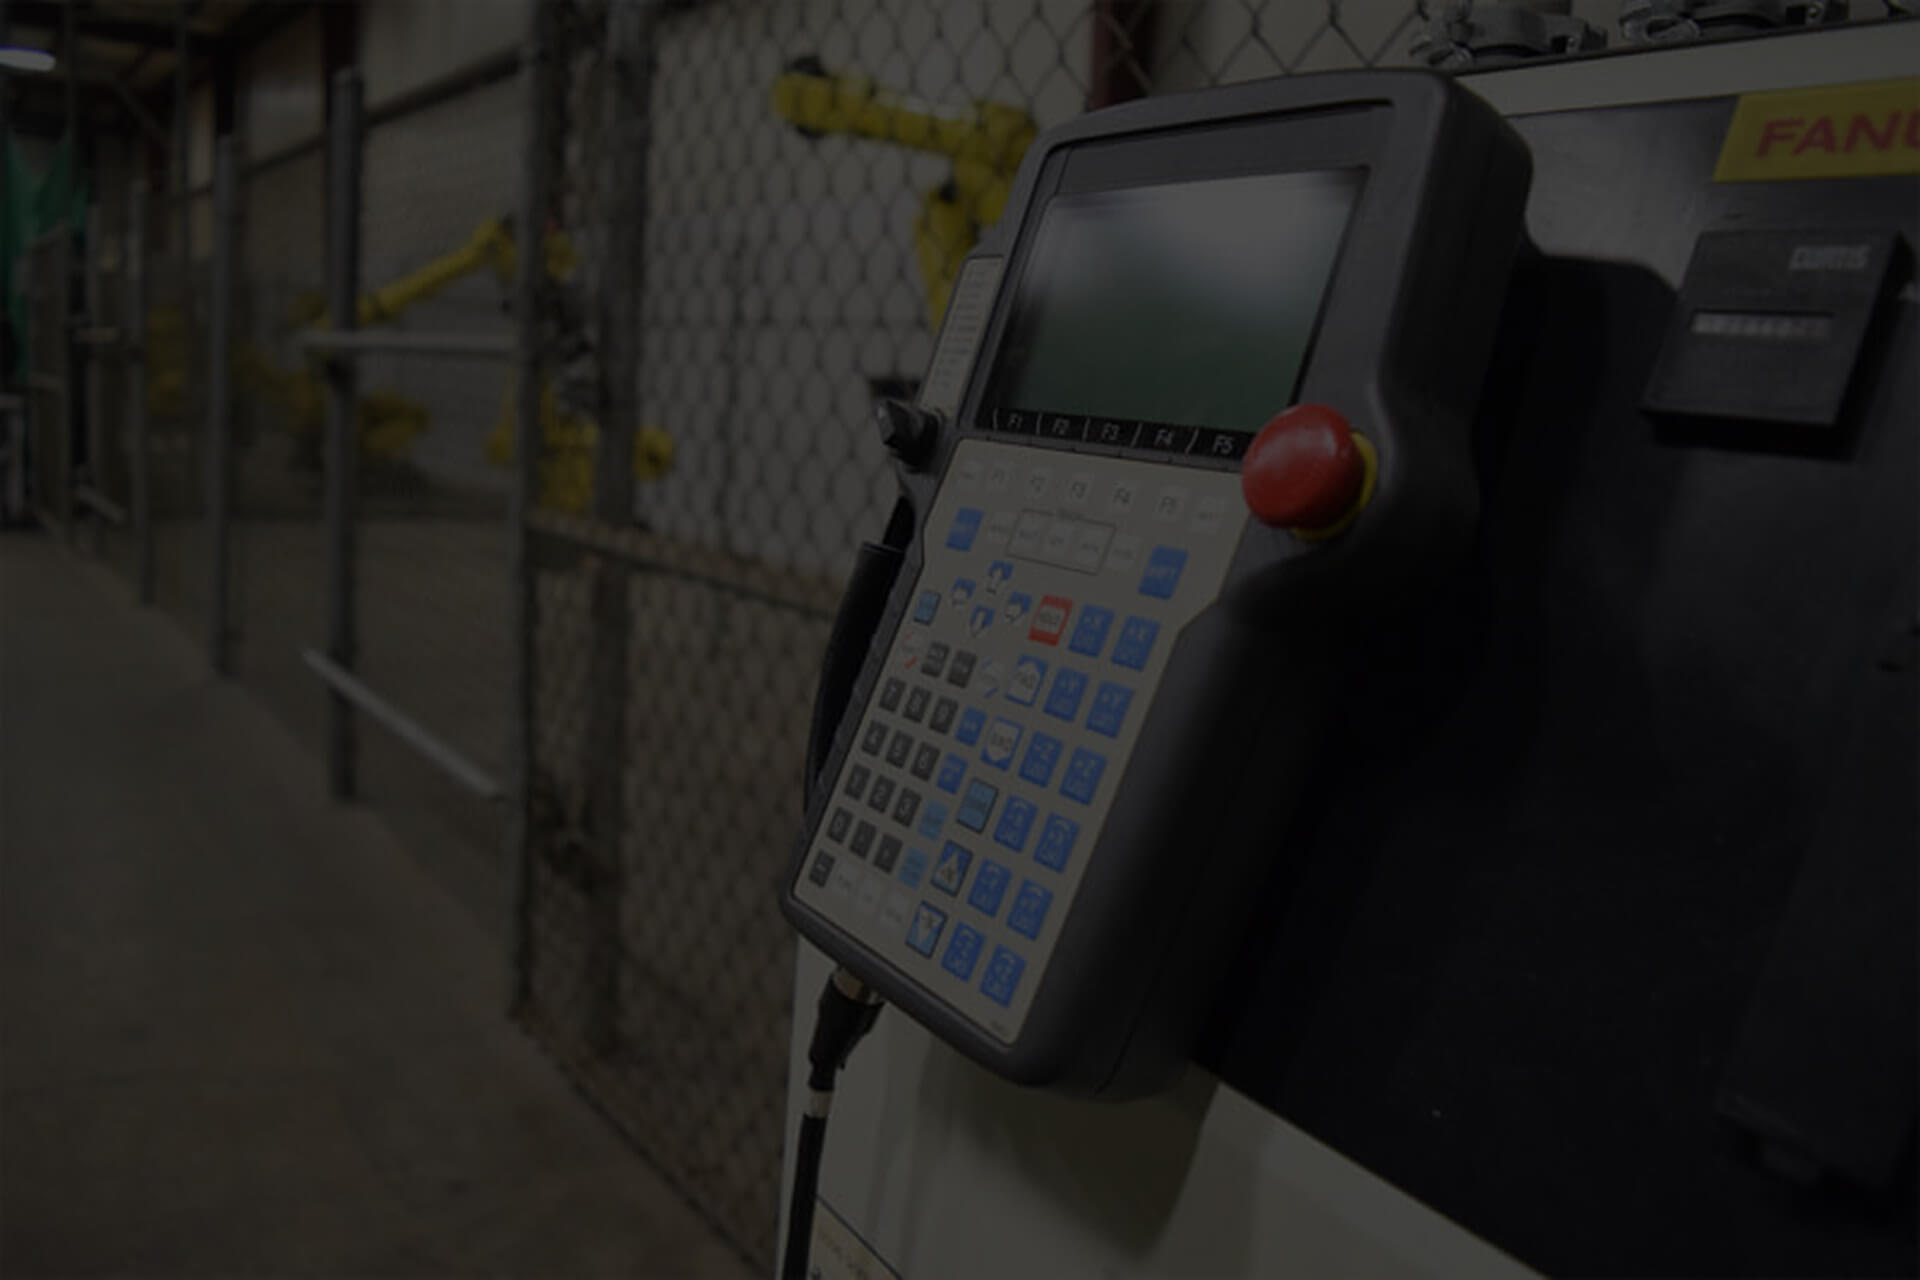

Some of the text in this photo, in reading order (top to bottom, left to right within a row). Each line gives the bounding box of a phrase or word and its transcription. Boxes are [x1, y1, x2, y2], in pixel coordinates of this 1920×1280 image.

[1007, 413, 1023, 428] F1
[1052, 418, 1070, 434] F2
[1101, 422, 1120, 441] F3
[1154, 428, 1176, 447] F4
[1212, 434, 1234, 454] F5
[1072, 481, 1087, 498] F3
[1113, 487, 1132, 504] F4
[874, 785, 886, 804] 2
